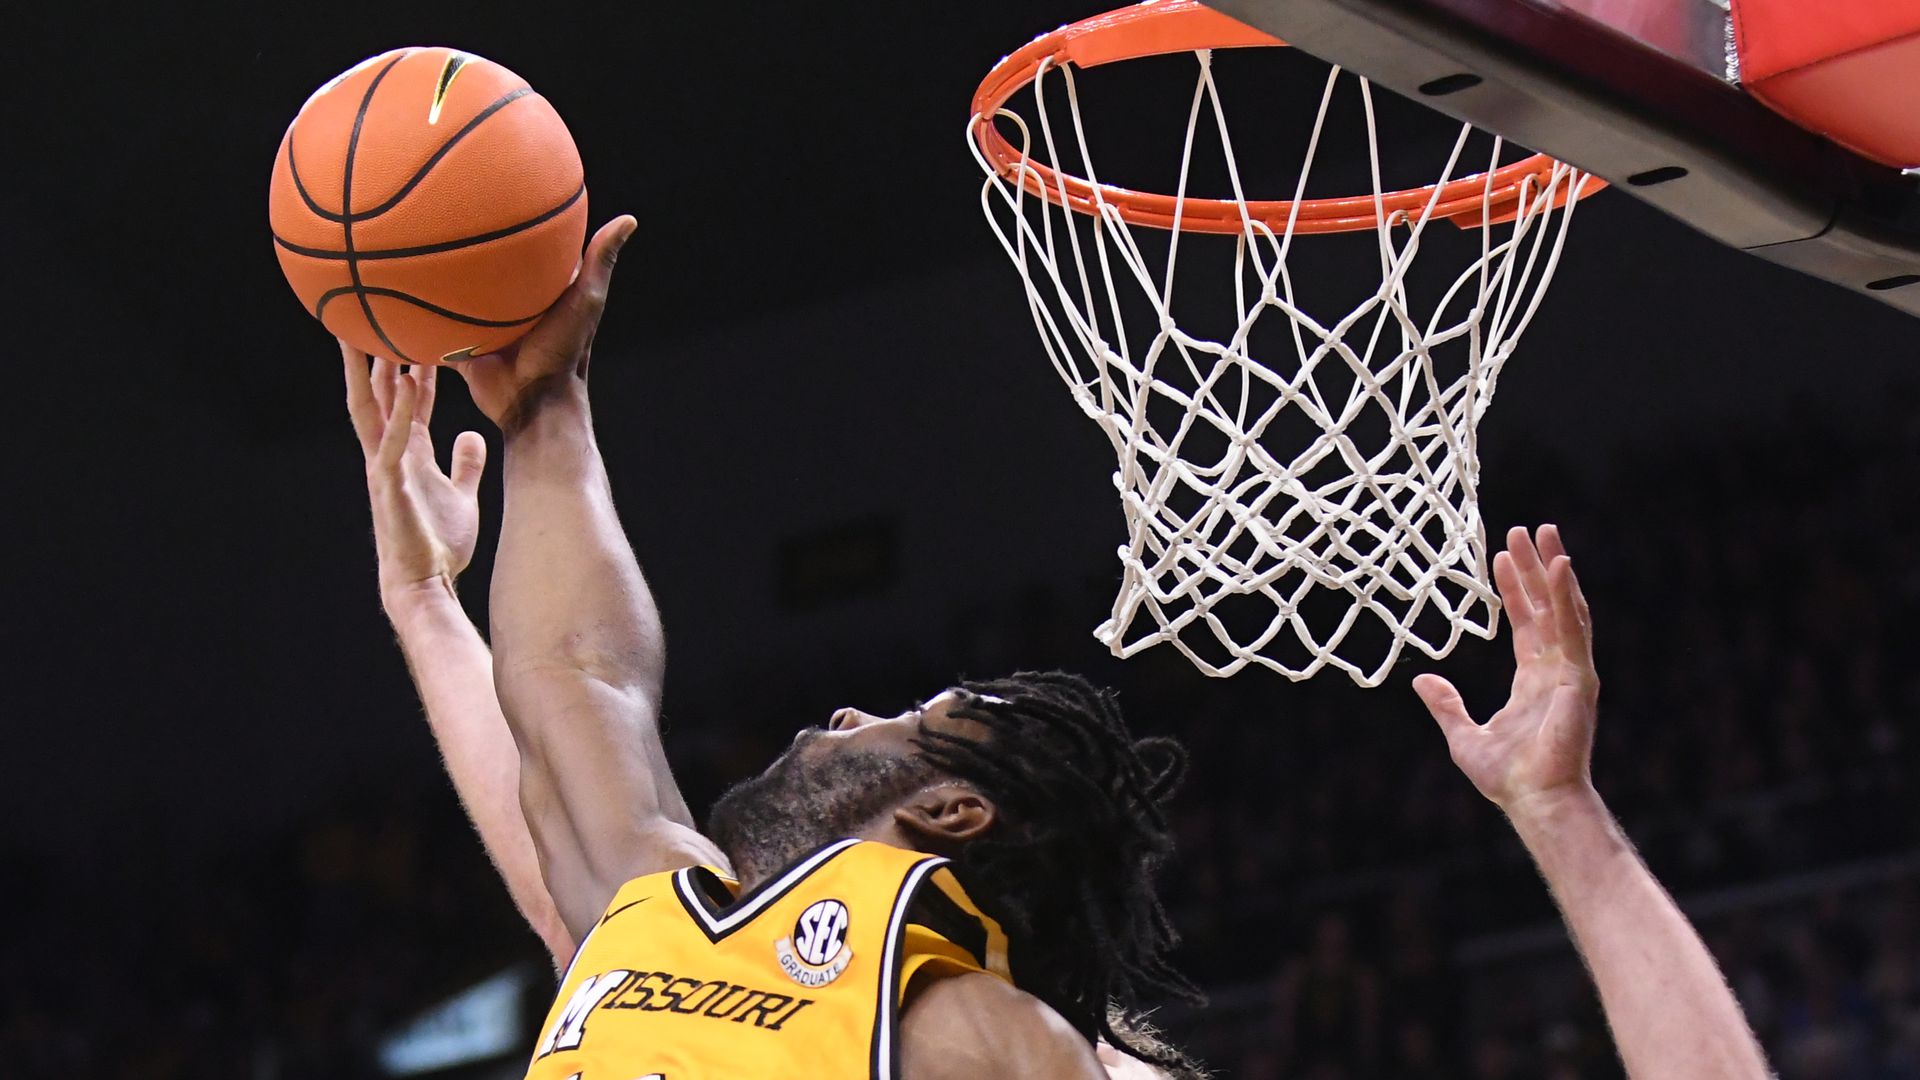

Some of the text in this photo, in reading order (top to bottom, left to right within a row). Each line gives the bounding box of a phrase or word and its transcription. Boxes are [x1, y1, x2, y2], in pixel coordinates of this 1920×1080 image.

[795, 900, 848, 965] SEC
[780, 953, 842, 986] GRADUATE
[535, 969, 815, 1062] MISSOURI
